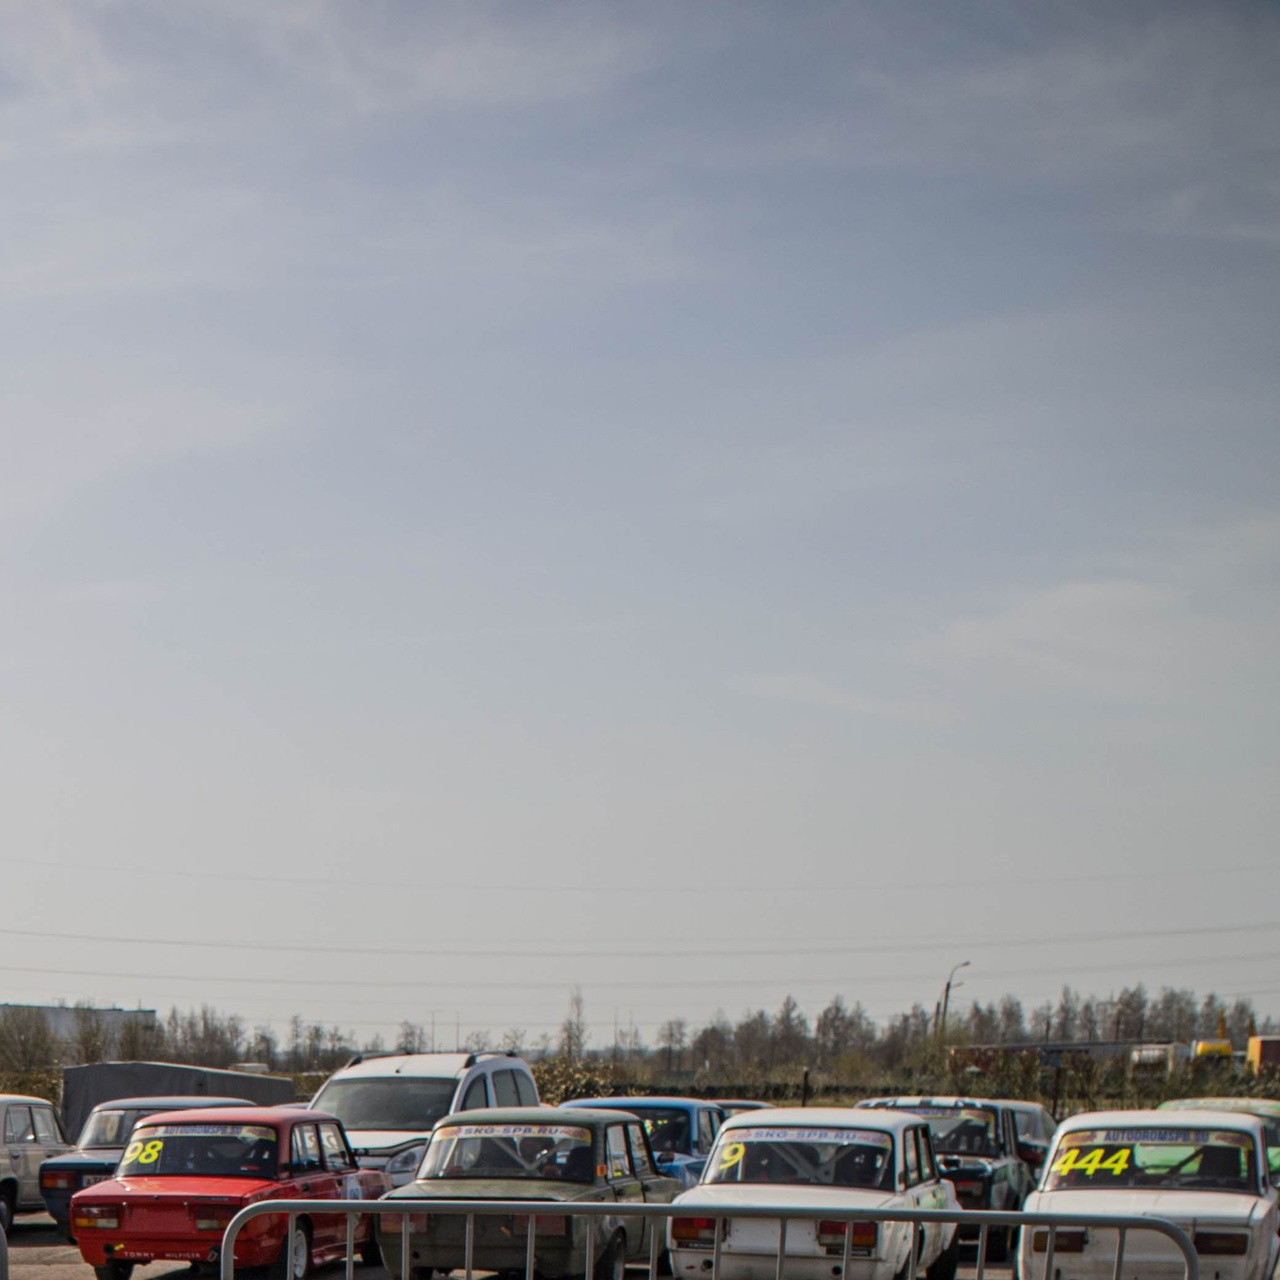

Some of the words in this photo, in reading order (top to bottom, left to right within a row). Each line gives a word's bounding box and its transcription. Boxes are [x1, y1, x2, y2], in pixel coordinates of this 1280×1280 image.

[120, 1140, 164, 1166] 98
[1051, 1148, 1131, 1176] 444
[123, 1251, 156, 1259] TOMMY
